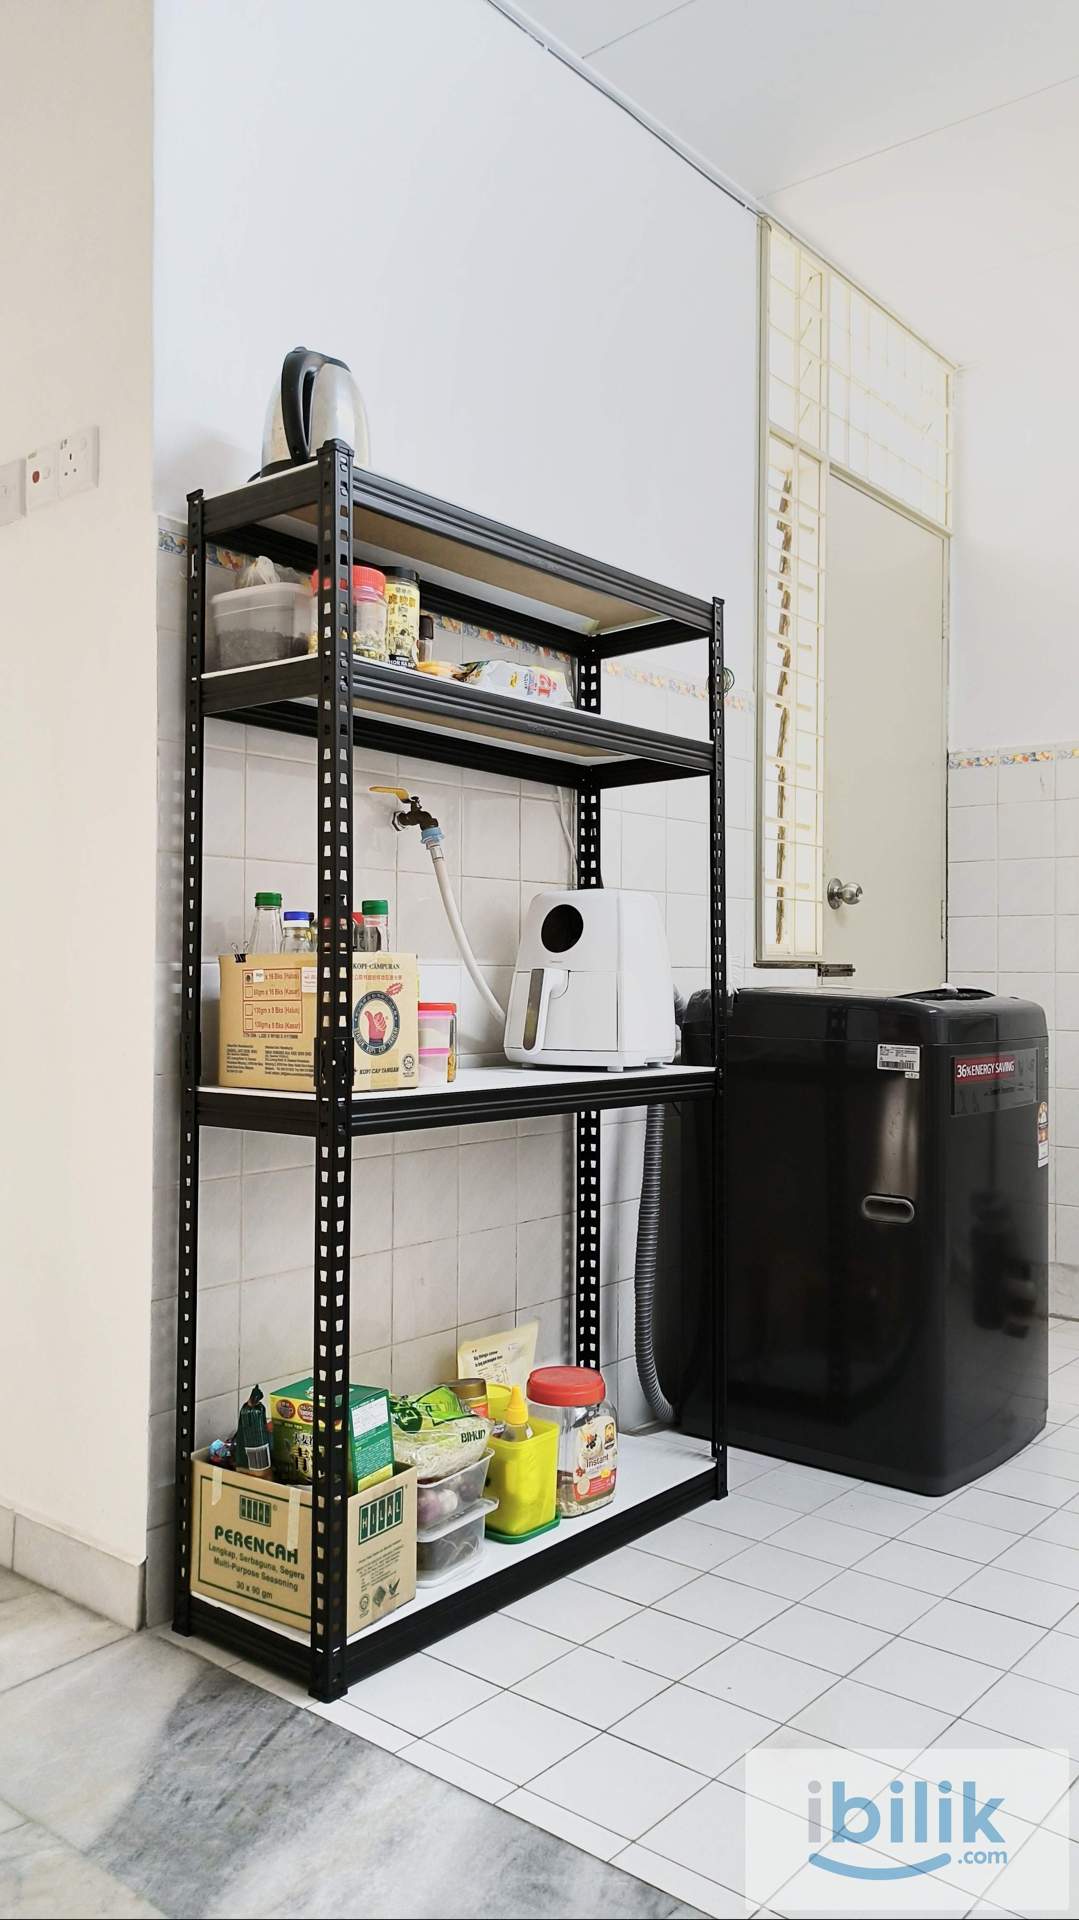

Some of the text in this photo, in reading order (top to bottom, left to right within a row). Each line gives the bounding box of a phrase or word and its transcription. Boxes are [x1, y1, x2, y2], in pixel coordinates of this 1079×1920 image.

[957, 1061, 1015, 1078] 36% ENERGY SAVING
[586, 1454, 609, 1468] Instant
[214, 1525, 298, 1565] PERENCAH
[214, 1556, 298, 1592] Multi-Purpose Seasoning
[279, 1565, 305, 1580] Segera
[261, 1589, 273, 1600] gm
